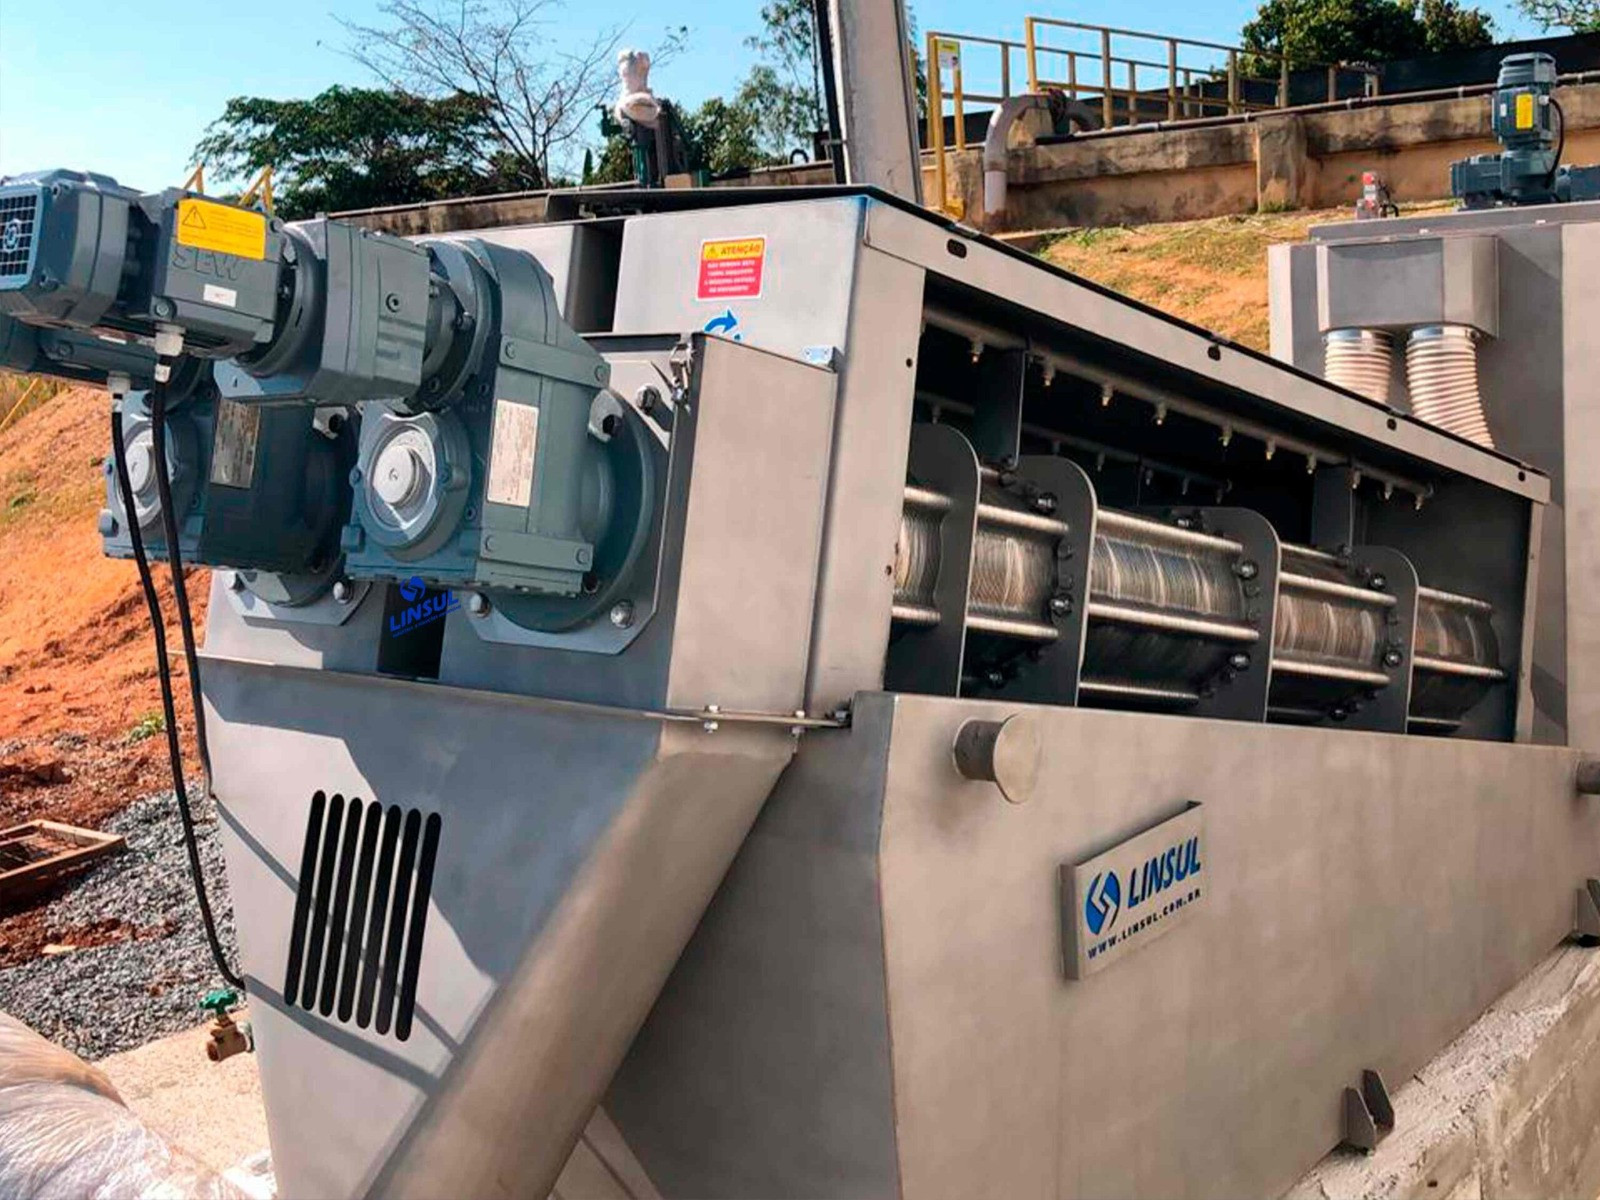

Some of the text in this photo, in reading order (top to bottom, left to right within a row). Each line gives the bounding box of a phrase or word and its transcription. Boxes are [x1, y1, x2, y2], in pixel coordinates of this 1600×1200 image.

[720, 242, 761, 255] ATENÇÃO
[1127, 836, 1202, 909] LINSUL
[1087, 888, 1202, 960] WWW.LINSUL.COM.BR
